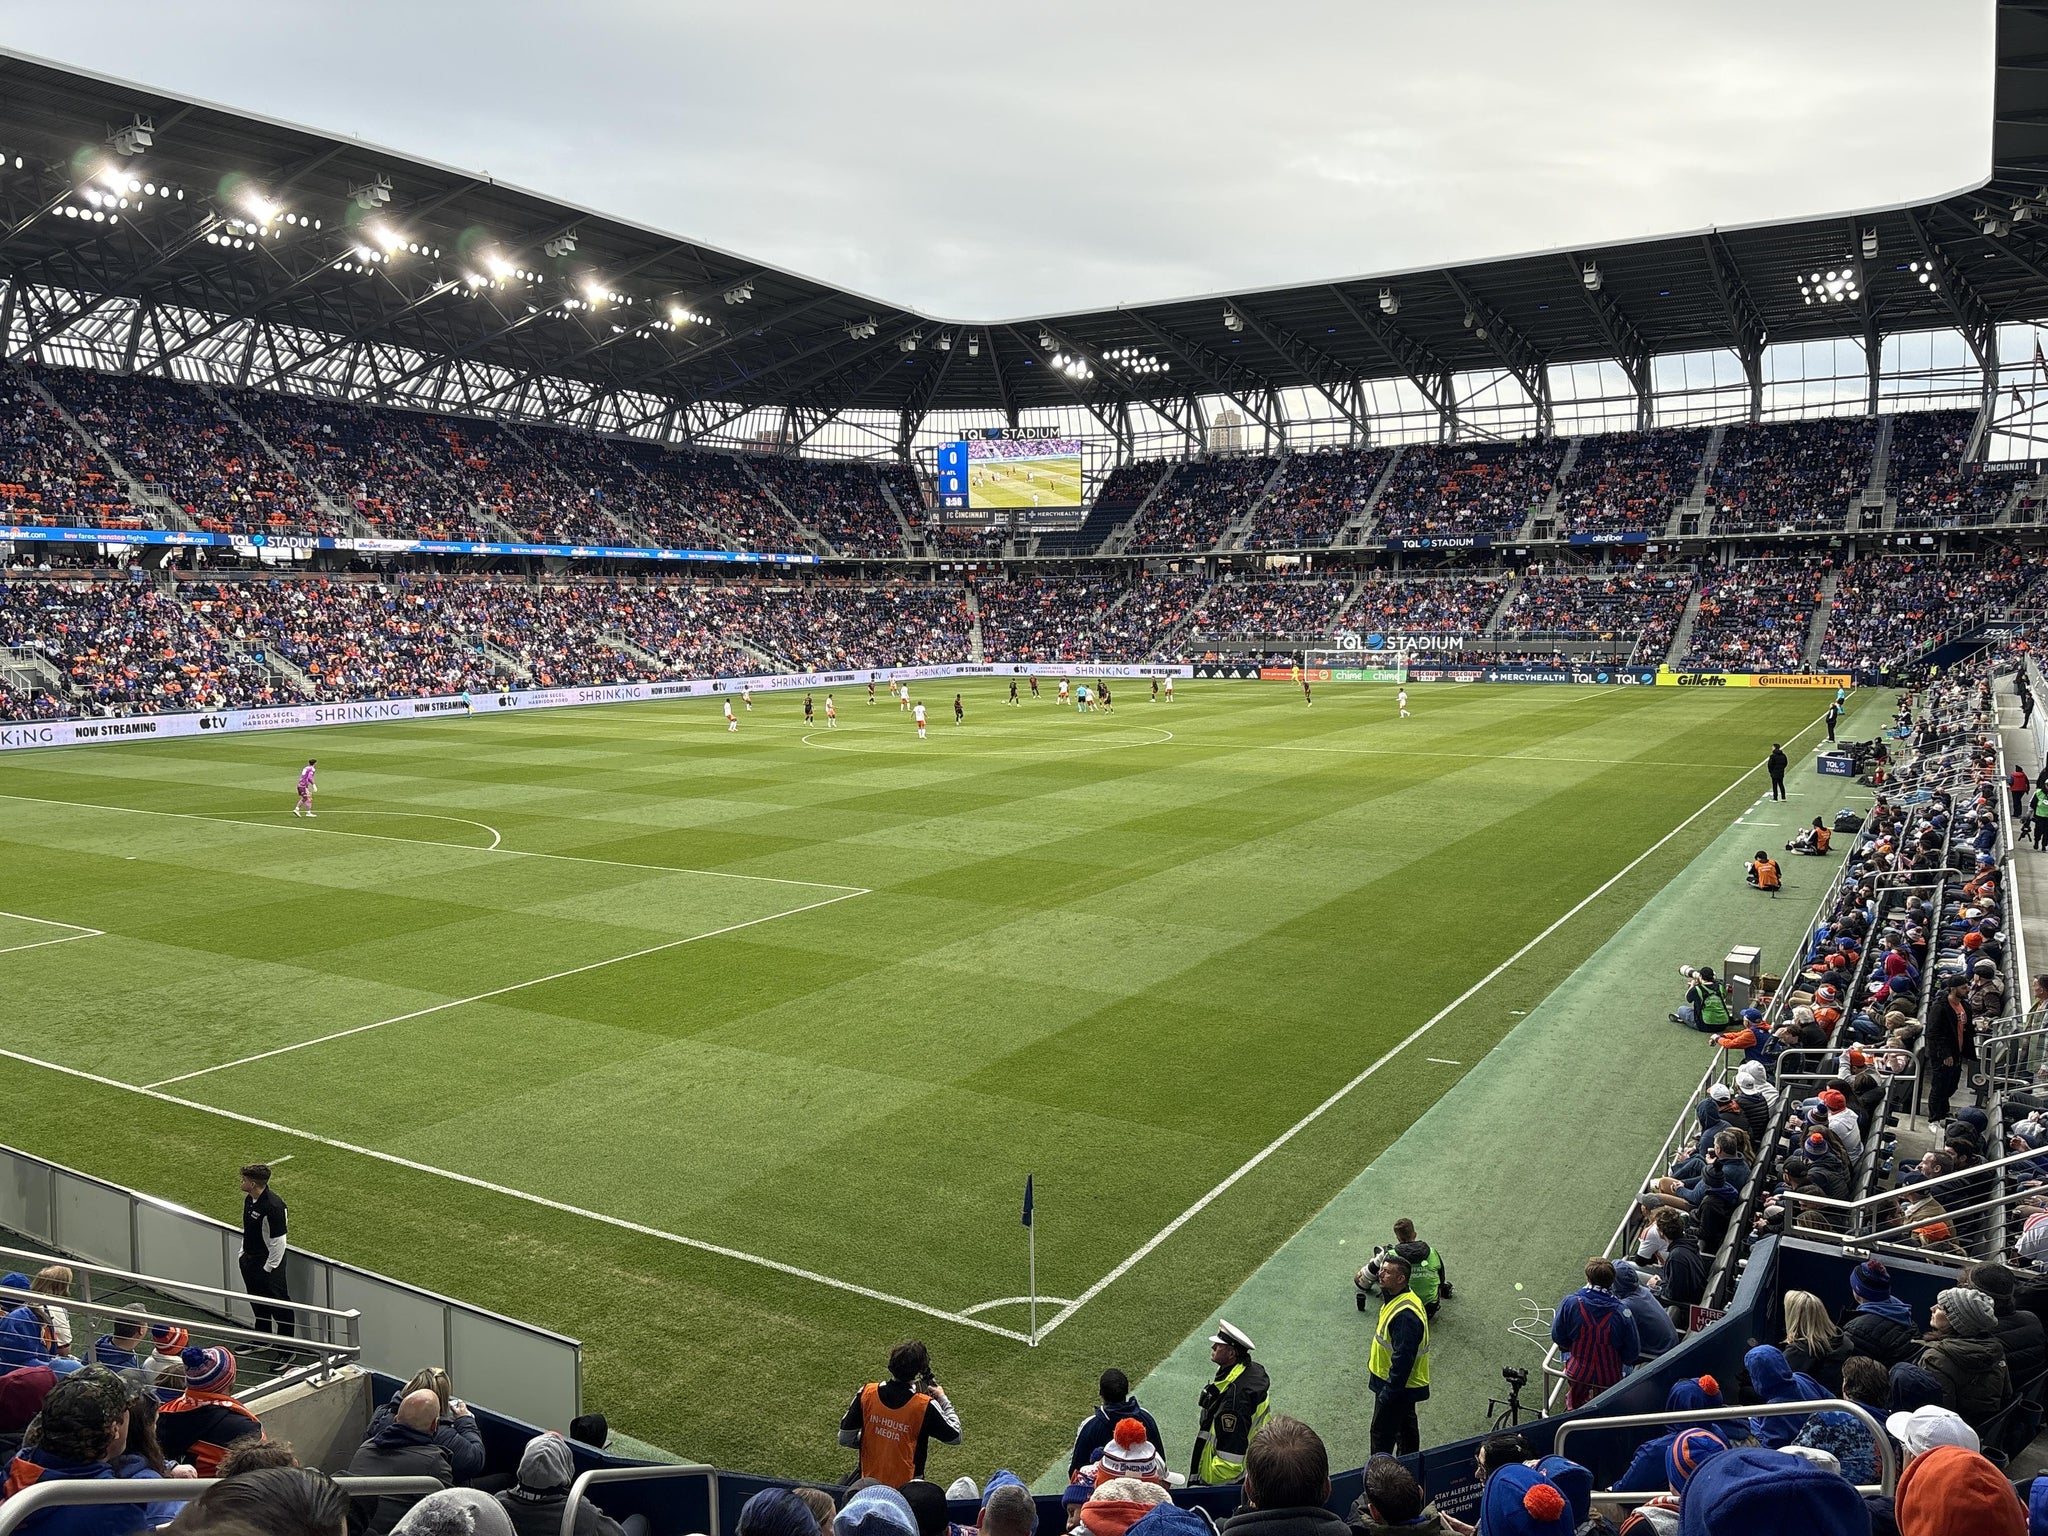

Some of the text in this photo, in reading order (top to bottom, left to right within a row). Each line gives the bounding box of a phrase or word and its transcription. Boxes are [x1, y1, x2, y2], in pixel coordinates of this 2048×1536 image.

[960, 427, 1060, 440] TQL STADIUM
[949, 452, 957, 464] 0
[950, 478, 958, 491] 0
[946, 511, 954, 519] FC
[228, 534, 320, 548] TQL STADIUM
[334, 538, 353, 549] 3:56
[1402, 538, 1474, 548] TQL STADIUM
[1592, 534, 1624, 543] altafiber
[1334, 635, 1464, 650] TQL STADIUM
[1336, 670, 1362, 681] chime
[1372, 670, 1399, 681] chime
[1410, 670, 1443, 678] DISCOUNT
[1448, 670, 1482, 678] DISCOUNT
[1500, 673, 1565, 681] MERCYHEALTH
[1572, 673, 1597, 683] TQL
[1615, 674, 1640, 685] TQL
[1677, 674, 1727, 686] Gillette
[1758, 675, 1843, 685] Continental Tire
[651, 685, 692, 695] NOW STREAMING
[718, 681, 727, 692] tv
[505, 695, 519, 707] tv
[414, 701, 468, 713] NOW STREAMIN
[213, 715, 228, 729] tv
[242, 719, 279, 727] HARRISON
[75, 722, 157, 738] NOW STREAMING
[1700, 1309, 1724, 1320] FIRE
[869, 1414, 910, 1433] IN-HOUSE
[875, 1426, 901, 1441] MEDIA
[1120, 1462, 1154, 1472] CINCINNAT
[1434, 1482, 1482, 1501] STAY ALERT FOR
[1436, 1498, 1458, 1510] BJECTS
[1455, 1502, 1473, 1513] PITCH
